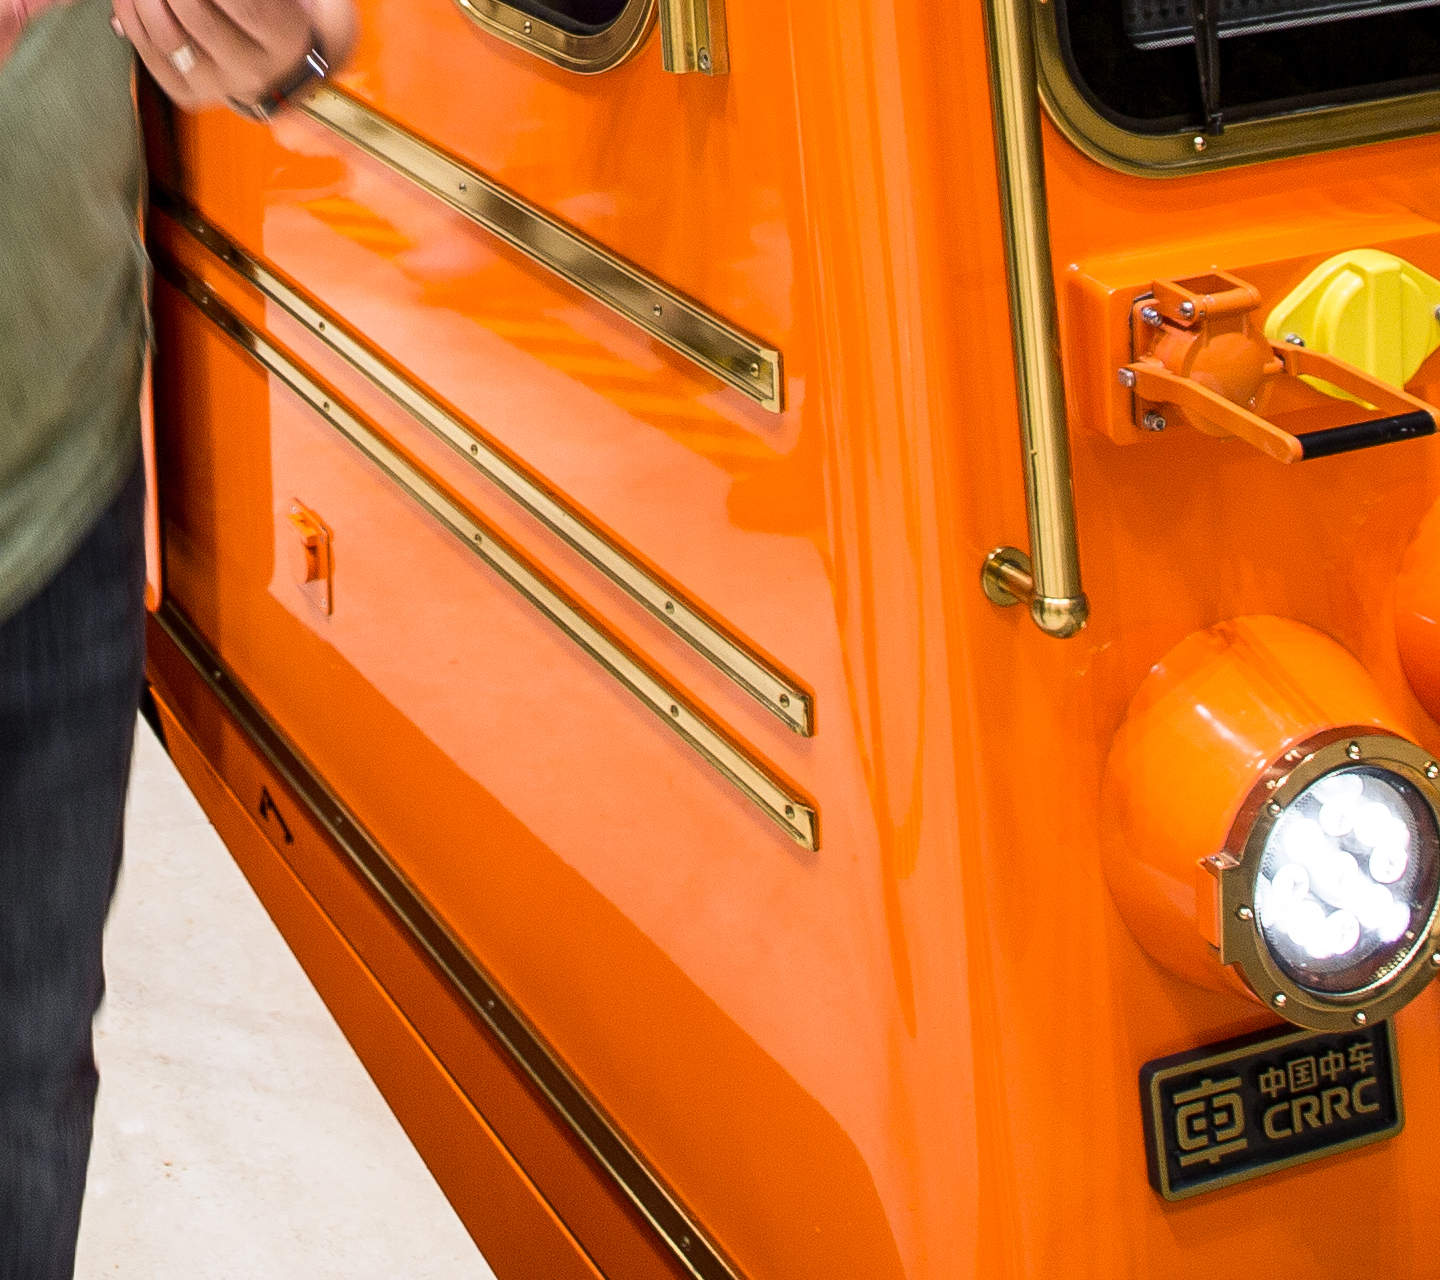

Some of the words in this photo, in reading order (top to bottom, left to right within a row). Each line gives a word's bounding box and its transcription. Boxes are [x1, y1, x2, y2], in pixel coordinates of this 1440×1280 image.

[1258, 1042, 1374, 1098] 中国中车
[1262, 1076, 1380, 1140] CRRC
